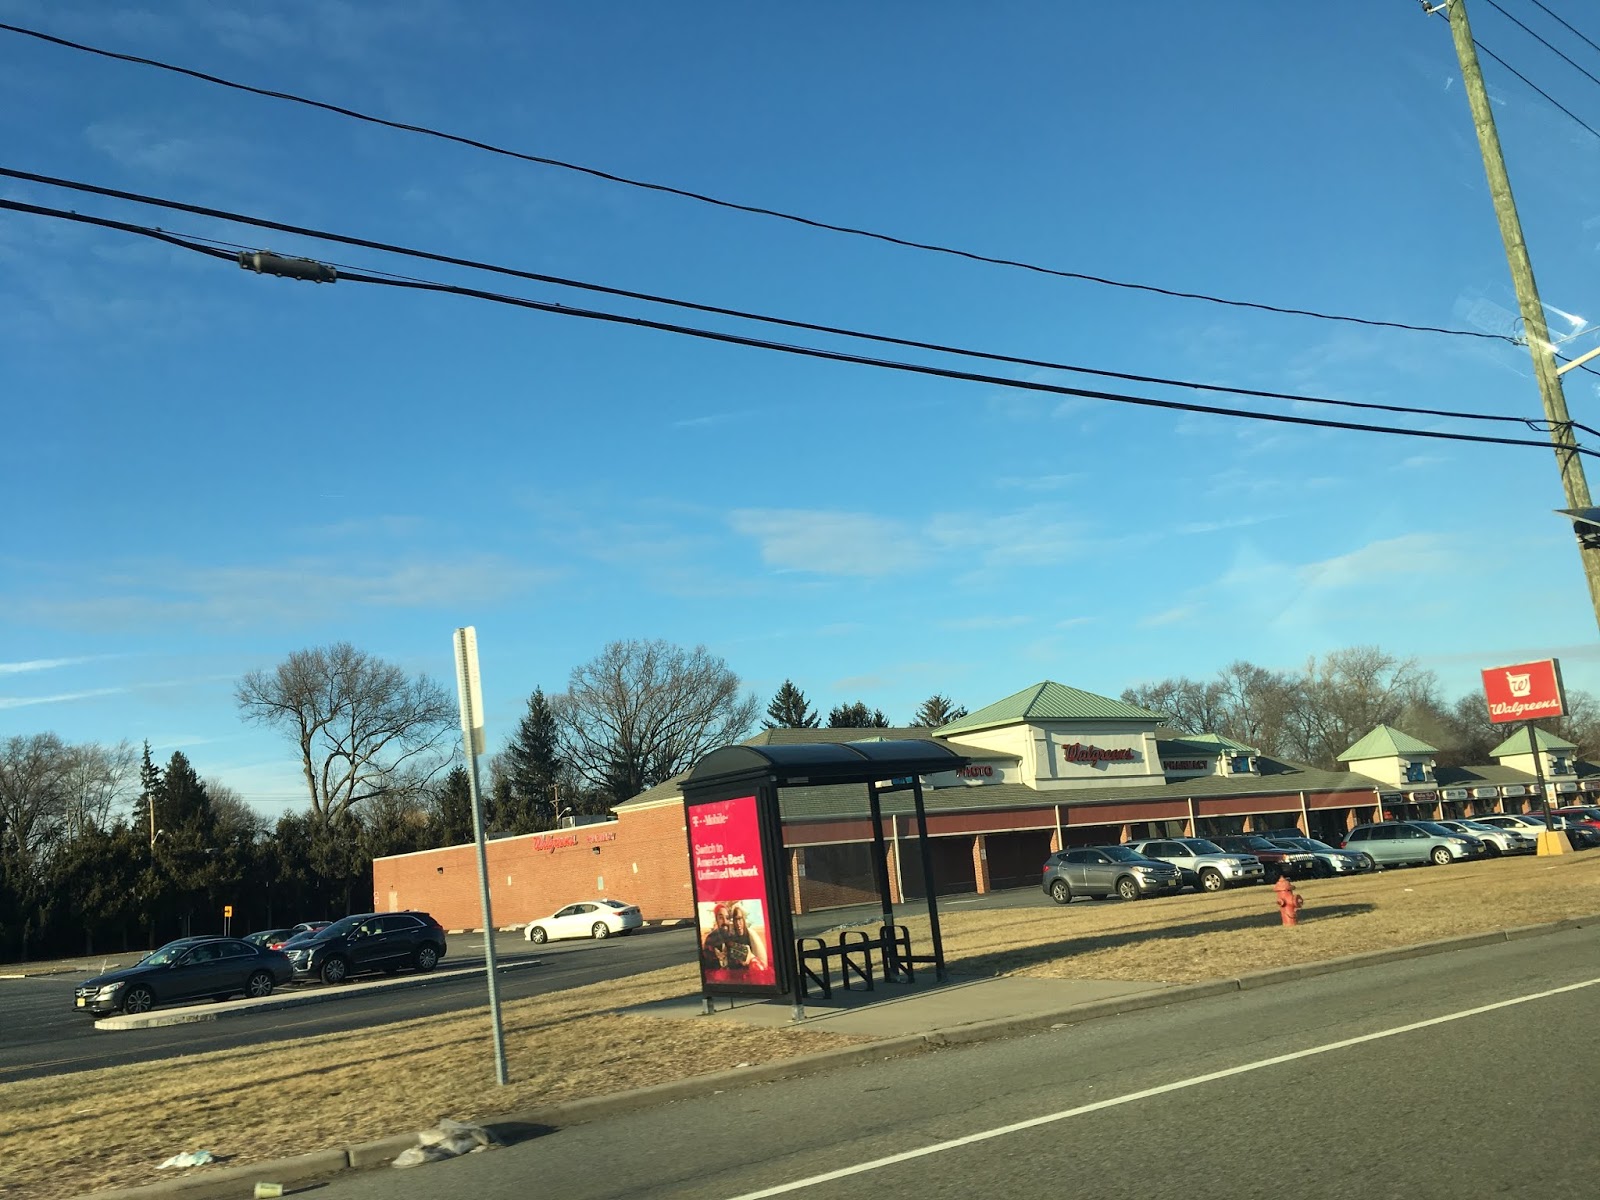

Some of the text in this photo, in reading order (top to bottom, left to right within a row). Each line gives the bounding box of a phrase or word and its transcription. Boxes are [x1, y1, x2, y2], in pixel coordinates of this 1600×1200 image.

[1490, 699, 1559, 716] Walgreens
[1061, 742, 1135, 768] Walgreens
[1163, 760, 1208, 771] PHARMACY
[695, 843, 723, 855] Switch to
[697, 853, 745, 868] America's Best
[698, 865, 758, 880] Unlimited Network
